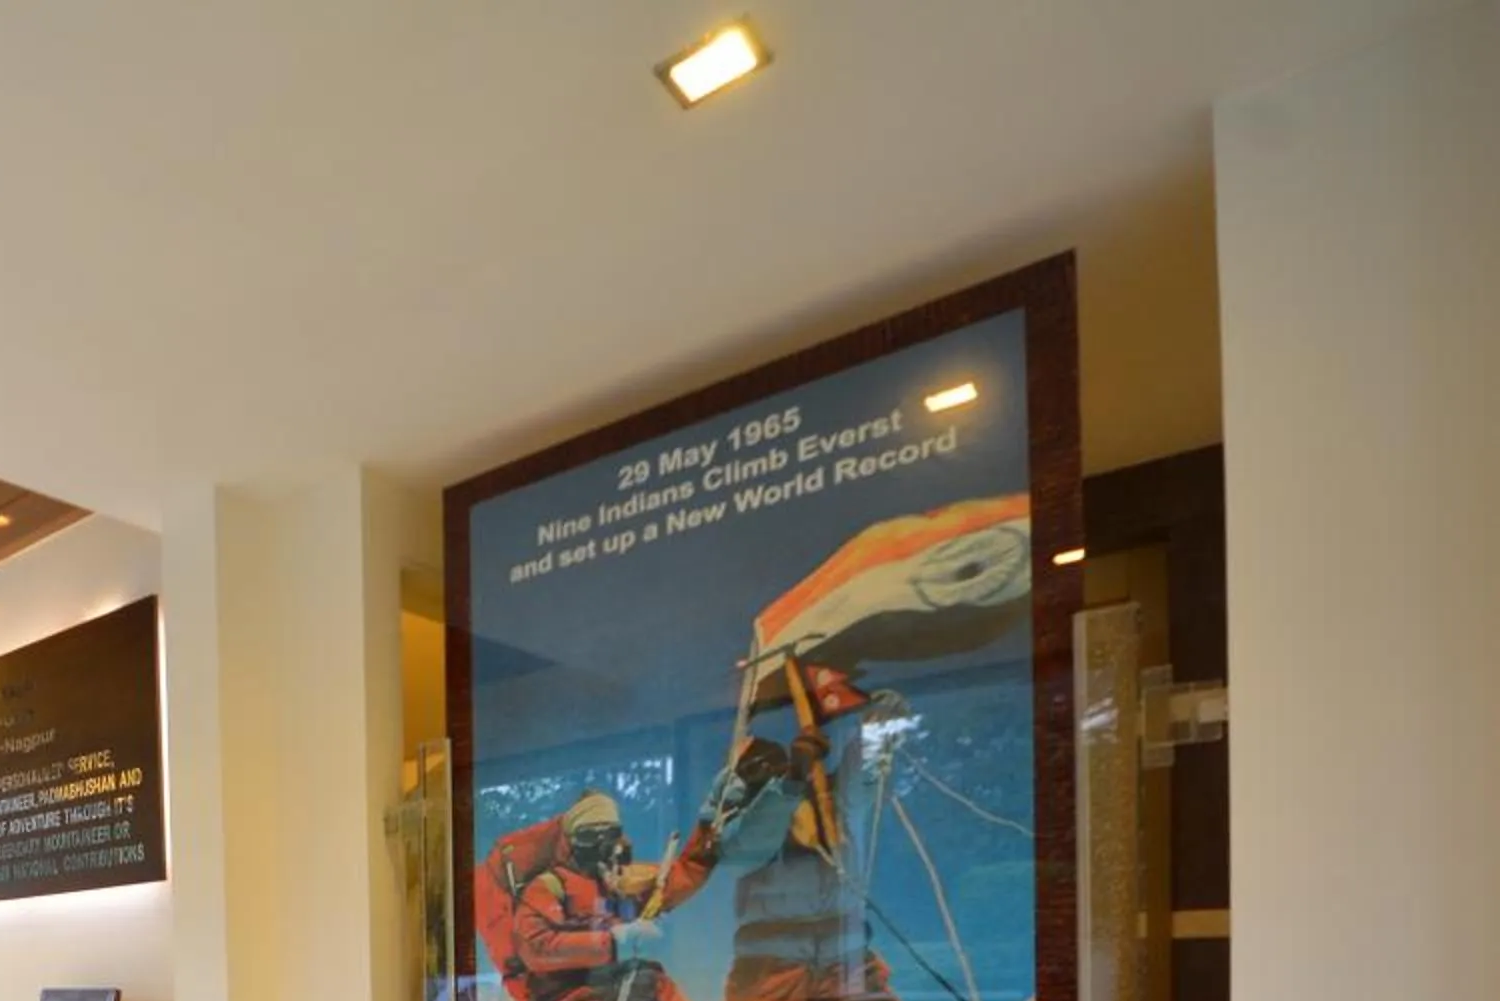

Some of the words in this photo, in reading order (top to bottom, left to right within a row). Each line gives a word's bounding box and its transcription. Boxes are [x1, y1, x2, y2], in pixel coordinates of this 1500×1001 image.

[536, 514, 592, 546] Nine
[598, 481, 694, 526] Indians
[702, 446, 788, 491] Climb
[797, 407, 903, 462] Everst
[619, 459, 650, 490] 29
[659, 440, 718, 478] May
[727, 406, 802, 450] 1965
[510, 553, 553, 584] and
[558, 542, 596, 569] set
[603, 529, 636, 556] up
[643, 523, 659, 543] a
[666, 501, 726, 535] New
[733, 464, 825, 514] World
[834, 427, 958, 484] Record
[37, 772, 116, 808] PADMABHUSHAN
[118, 766, 143, 790] AND
[66, 746, 115, 777] SERVICE,
[8, 810, 60, 836] ADVENTURE
[63, 799, 111, 826] THROUGH
